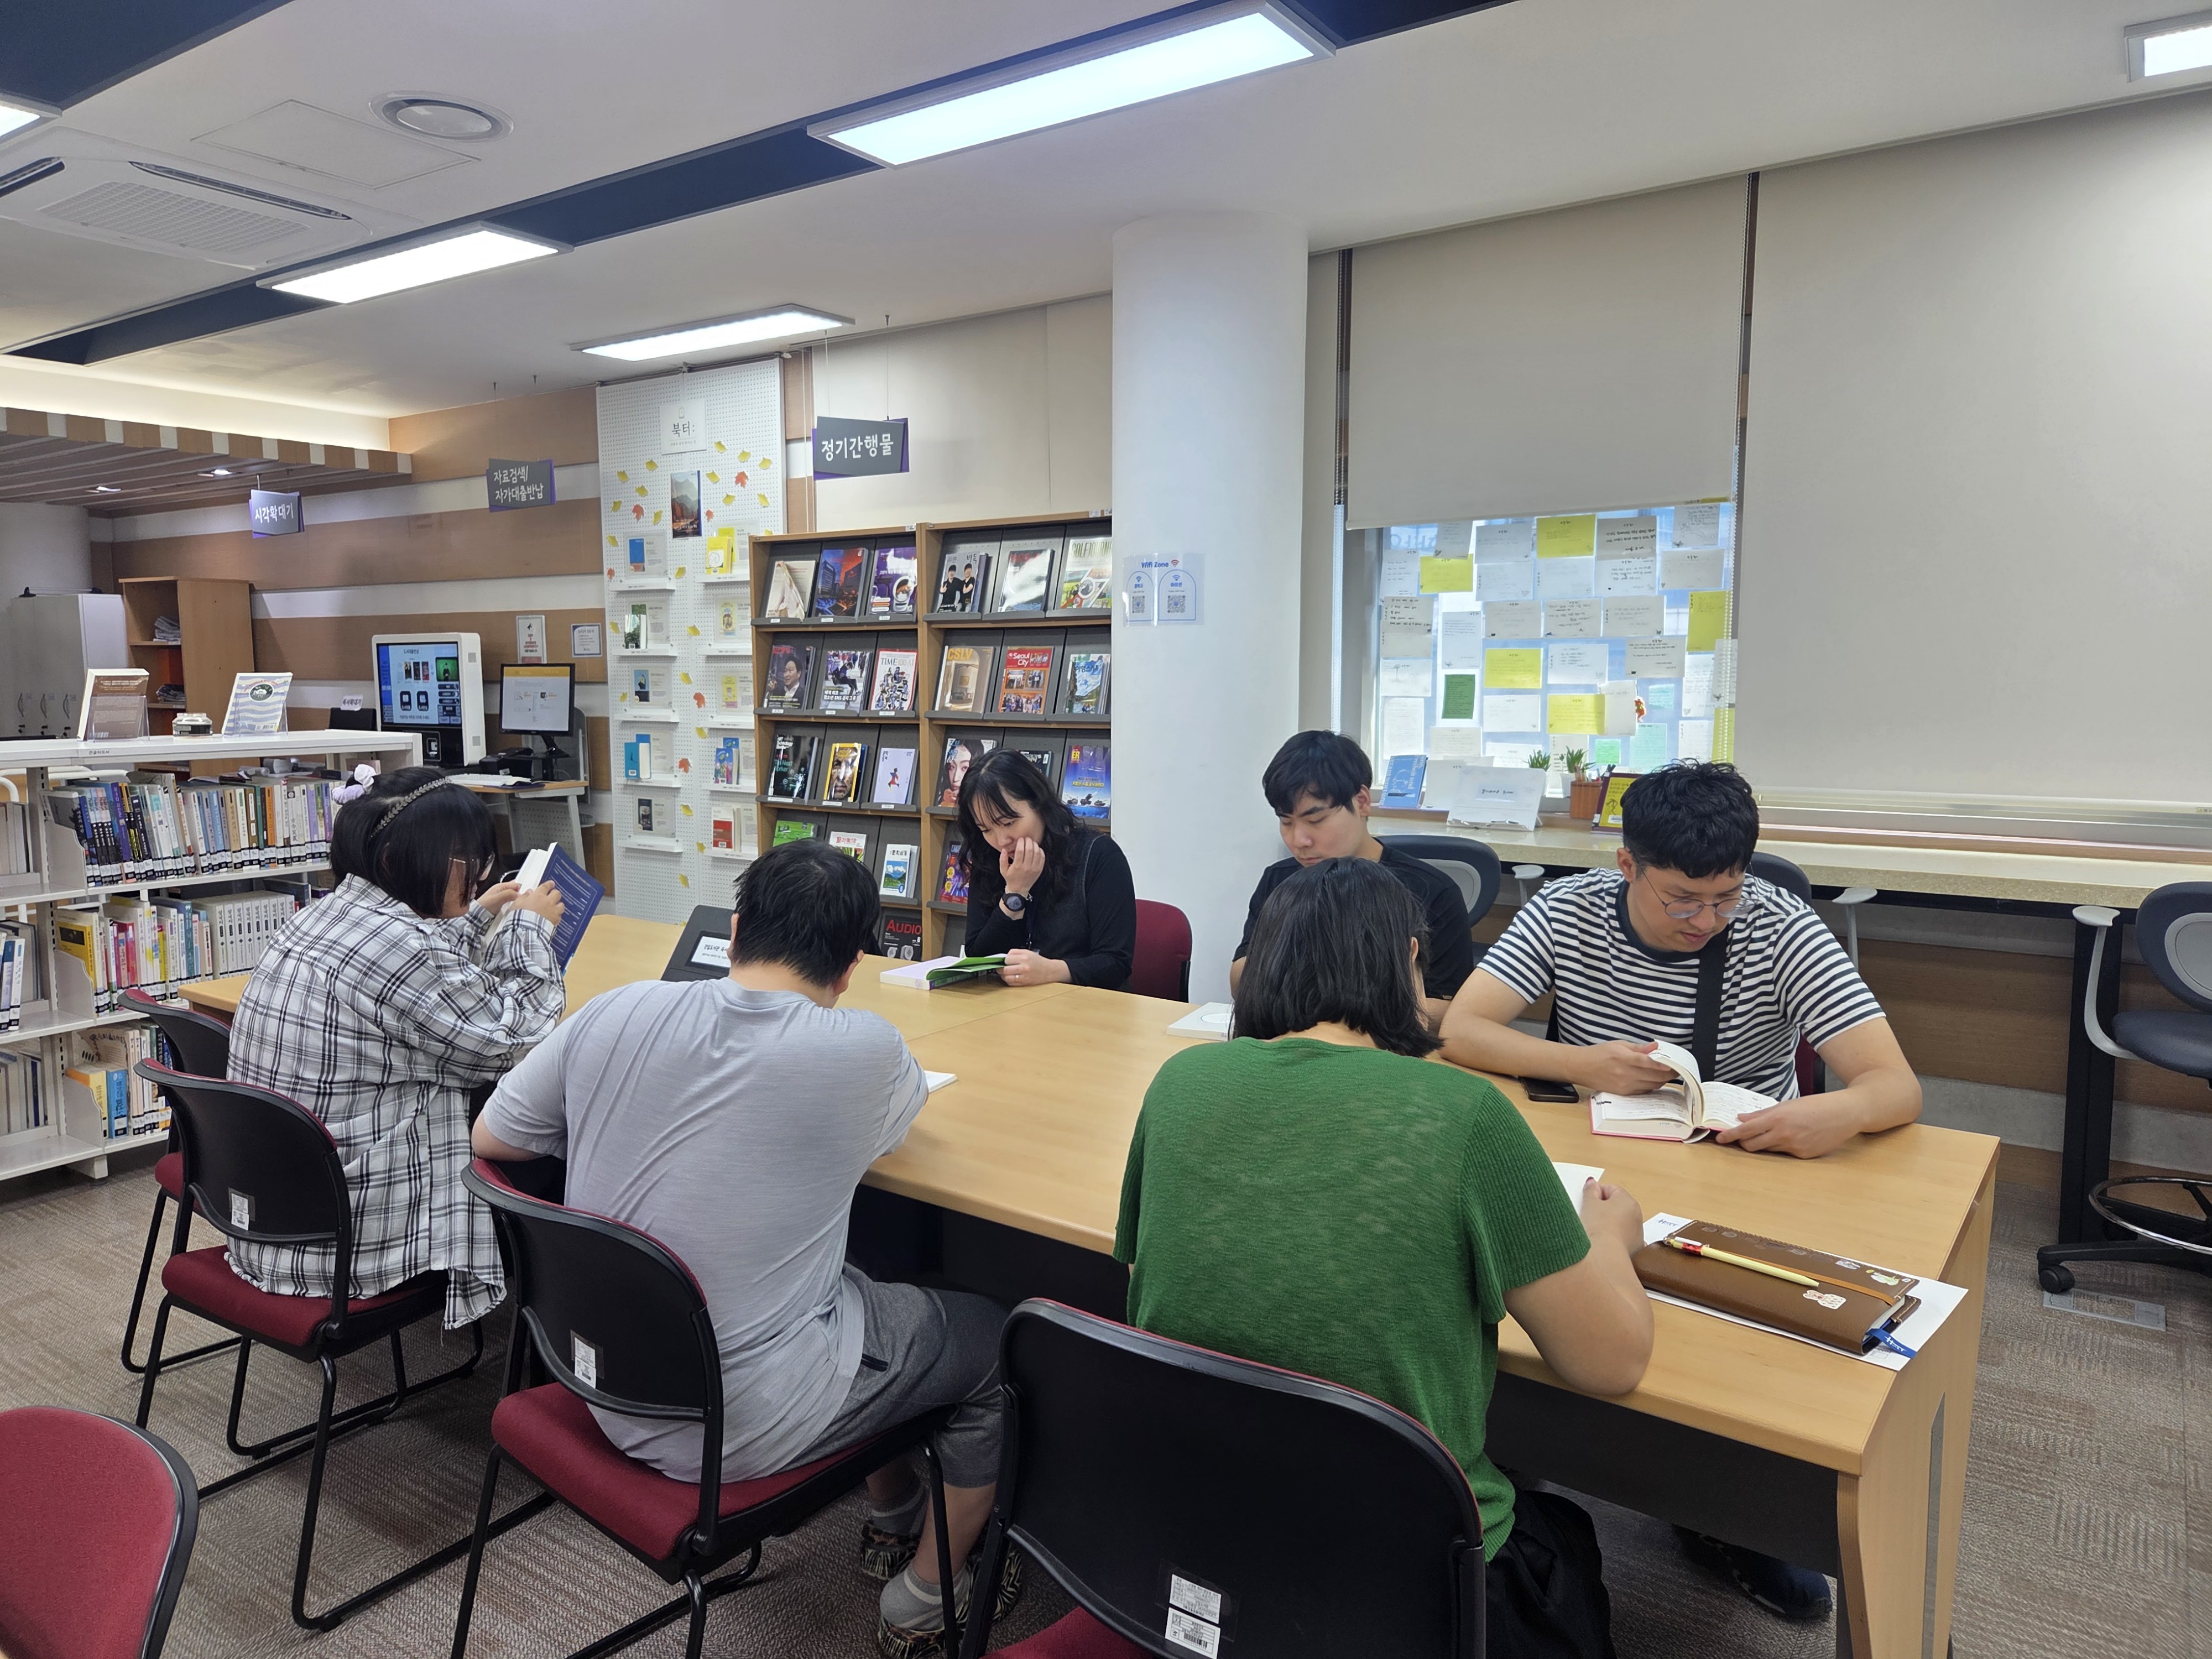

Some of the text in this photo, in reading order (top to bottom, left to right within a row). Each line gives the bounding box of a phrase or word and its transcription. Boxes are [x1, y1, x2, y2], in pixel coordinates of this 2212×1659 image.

[822, 434, 894, 461] 정기간행물
[494, 465, 528, 485] 자료검색/
[495, 483, 544, 503] 자가대출반납
[255, 503, 294, 523] 시각확대기
[966, 554, 977, 564] 바둑
[947, 648, 973, 660] CSLV
[1018, 659, 1029, 667] City
[886, 919, 921, 935] AUDIO
